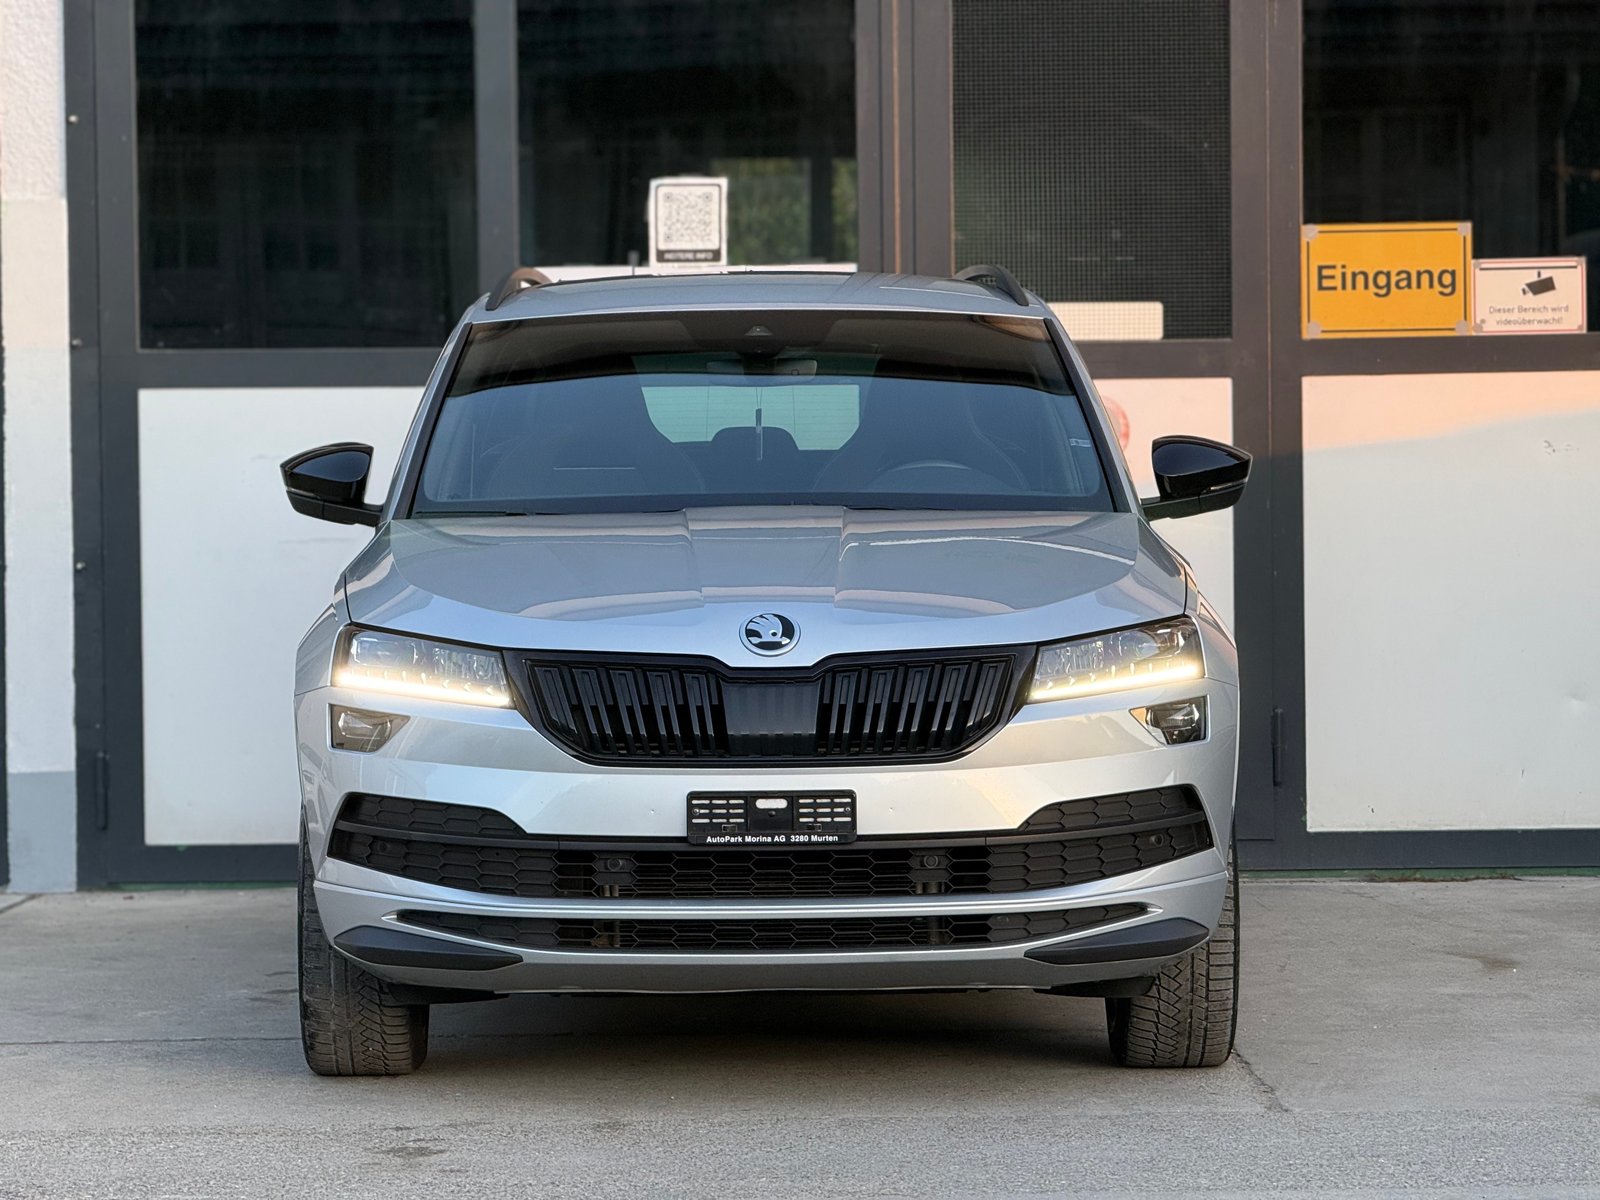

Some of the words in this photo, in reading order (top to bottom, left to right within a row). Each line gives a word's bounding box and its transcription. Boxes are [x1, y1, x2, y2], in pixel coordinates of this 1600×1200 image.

[1317, 264, 1456, 298] Eingang
[1489, 306, 1515, 314] Dieser
[1518, 305, 1547, 313] Bereich
[1550, 304, 1569, 312] wird
[706, 835, 743, 843] AutoPark
[774, 834, 786, 842] AG
[790, 834, 809, 842] 3280
[811, 834, 839, 842] Murten
